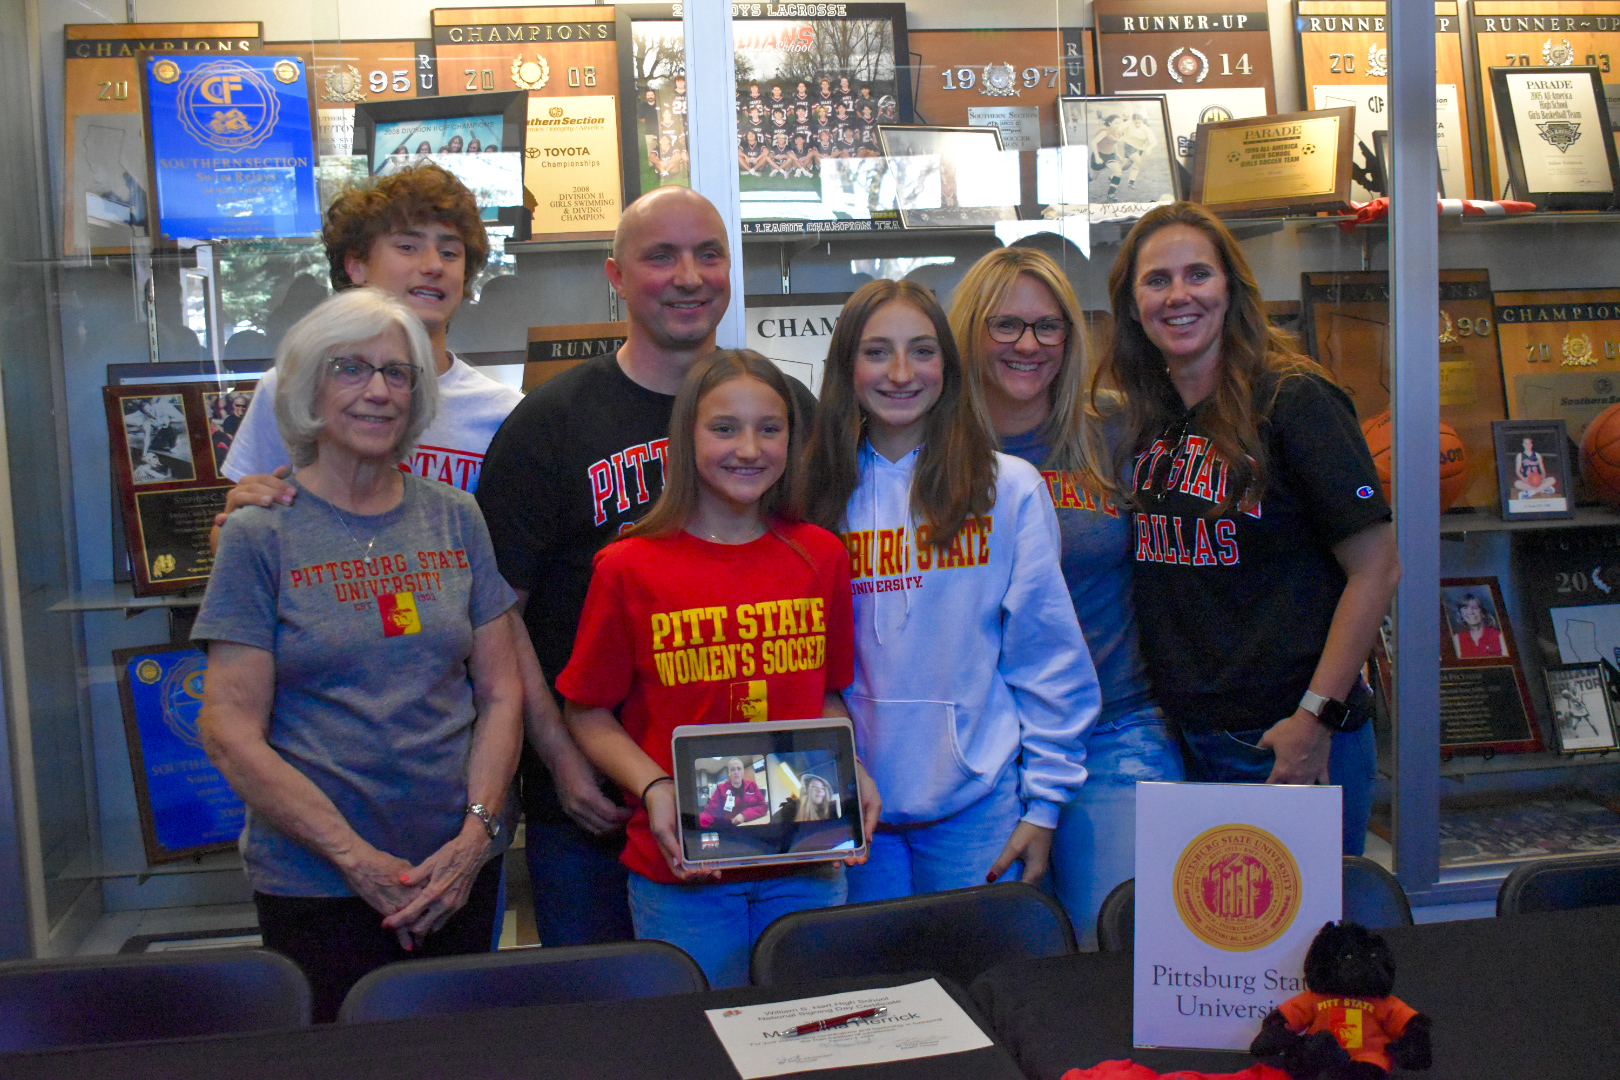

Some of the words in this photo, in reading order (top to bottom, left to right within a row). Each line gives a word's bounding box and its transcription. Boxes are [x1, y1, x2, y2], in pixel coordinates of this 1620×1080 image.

[732, 4, 762, 18] OYS
[766, 4, 848, 18] LACROSSE
[1123, 15, 1248, 32] RUNNER-UP
[449, 24, 608, 43] CHAMPIONS
[1122, 55, 1157, 77] 20
[1219, 53, 1253, 76] 14
[1329, 53, 1356, 74] 20
[369, 70, 412, 93] 95
[465, 69, 494, 91] 20
[567, 66, 598, 88] 08
[941, 68, 977, 91] 19
[1021, 67, 1060, 89] 97
[1526, 80, 1574, 90] PARADE
[98, 80, 129, 101] 20
[562, 116, 605, 126] Section
[1244, 125, 1302, 141] PARADE
[543, 146, 591, 158] TOYOTA
[1250, 152, 1267, 161] HIGH
[1268, 150, 1291, 159] SCHOOL
[1283, 155, 1301, 164] TEAM
[244, 156, 309, 169] SECTION
[541, 160, 601, 169] Championships
[550, 200, 572, 208] GIRLS
[573, 199, 615, 208] SWIMMING
[559, 192, 596, 201] DIVISION
[560, 213, 605, 222] CHAMPION
[572, 206, 602, 215] DIVING
[755, 222, 804, 233] LEAGUE
[805, 220, 872, 232] CHAMPION
[874, 220, 901, 230] TEA
[1136, 513, 1240, 567] RILLAS
[291, 553, 409, 588] PITTSBURG
[417, 549, 469, 571] STATE
[334, 571, 442, 603] UNIVERSITY
[651, 605, 729, 651] PITT
[736, 597, 827, 641] STATE
[653, 642, 757, 687] WOMEN'S
[761, 634, 826, 676] SOCCER
[1221, 834, 1253, 848] STATE
[1152, 964, 1258, 996] Pittsburg
[1262, 971, 1310, 992] Stat
[1176, 994, 1284, 1019] Universi
[1317, 999, 1340, 1012] PITT
